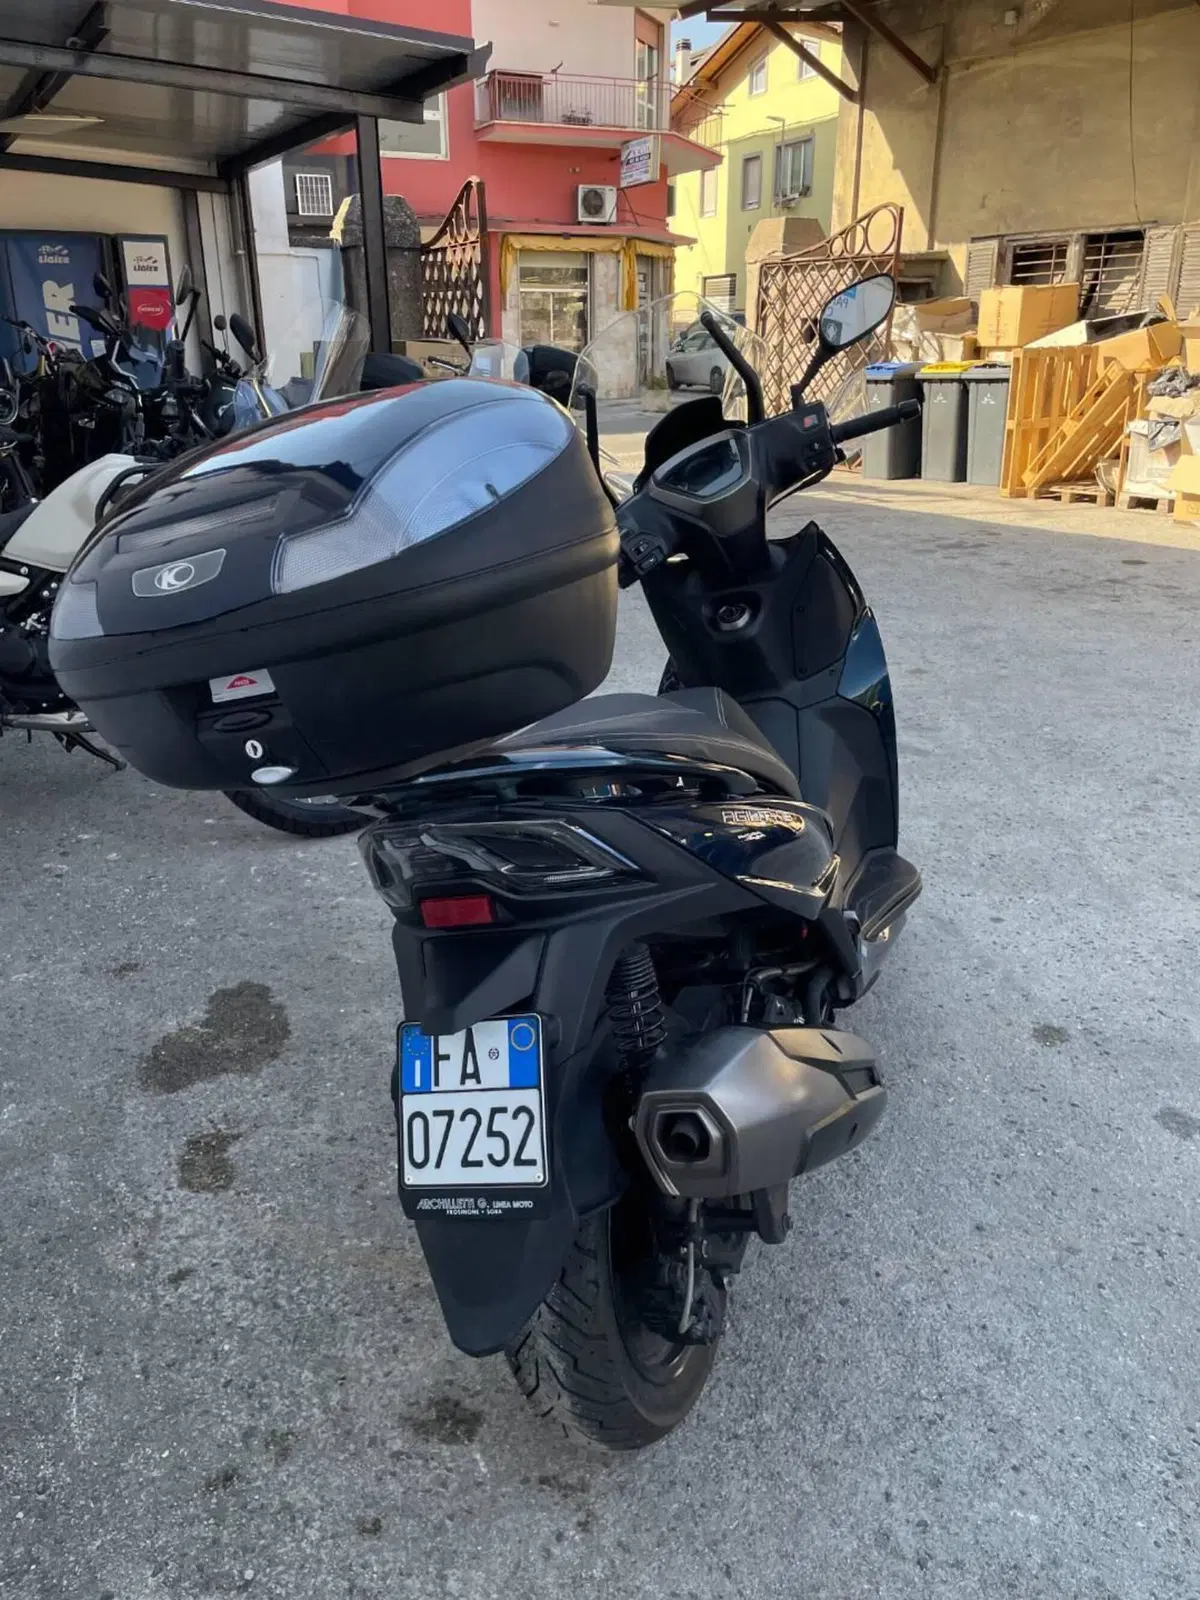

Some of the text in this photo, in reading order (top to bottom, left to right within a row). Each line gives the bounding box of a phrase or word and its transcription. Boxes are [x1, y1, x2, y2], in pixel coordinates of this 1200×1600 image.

[433, 1028, 481, 1087] FA
[407, 1105, 538, 1170] 07252
[512, 1200, 534, 1209] MOTO
